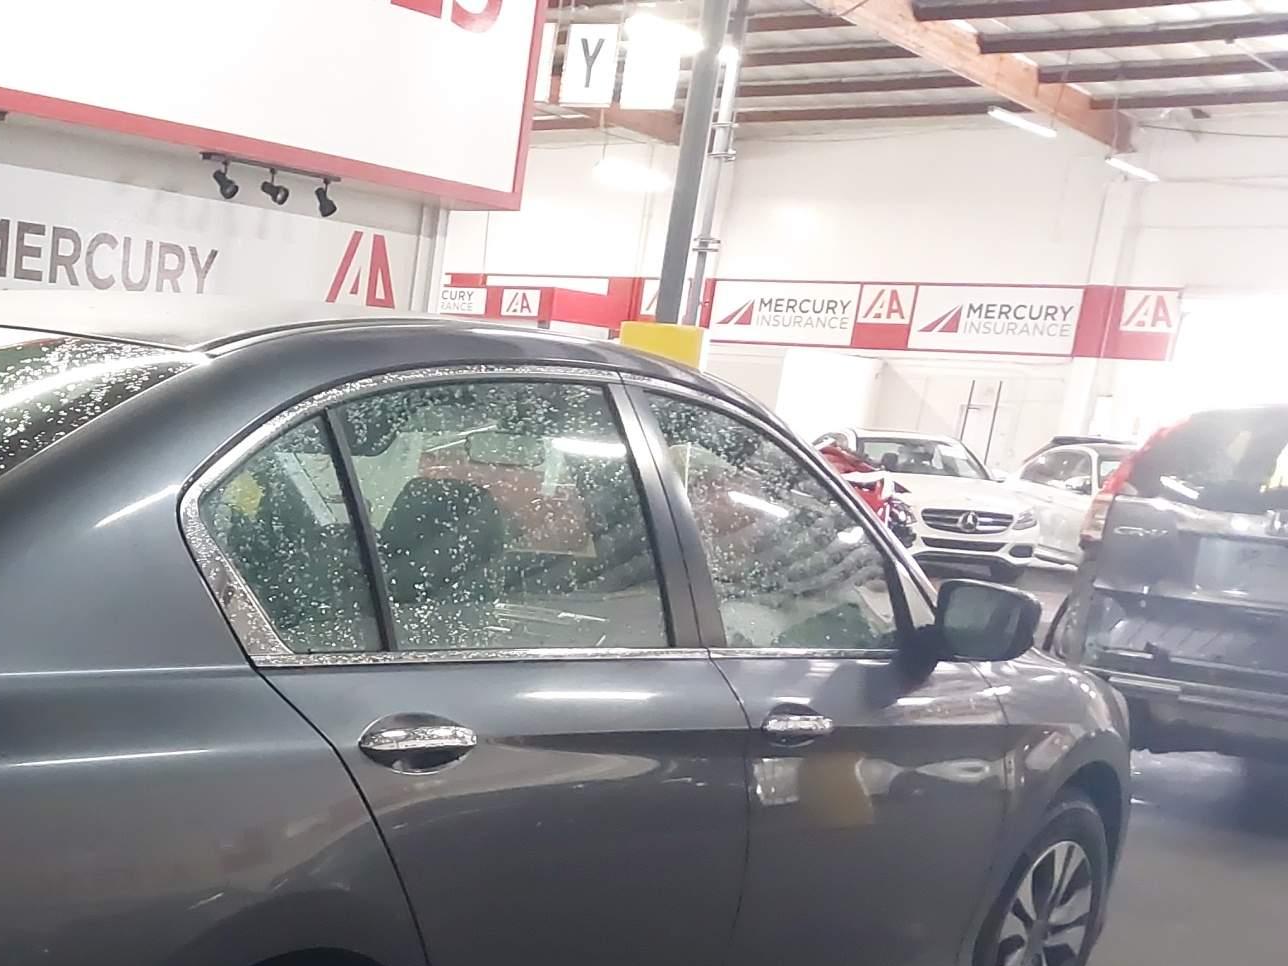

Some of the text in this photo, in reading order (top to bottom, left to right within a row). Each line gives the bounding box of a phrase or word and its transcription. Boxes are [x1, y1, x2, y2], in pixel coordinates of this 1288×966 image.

[580, 37, 606, 88] Y
[758, 298, 852, 315] MERCURY
[966, 303, 1075, 321] MERCURY
[756, 314, 849, 330] INSURANCE
[963, 320, 1073, 337] INSURANCE
